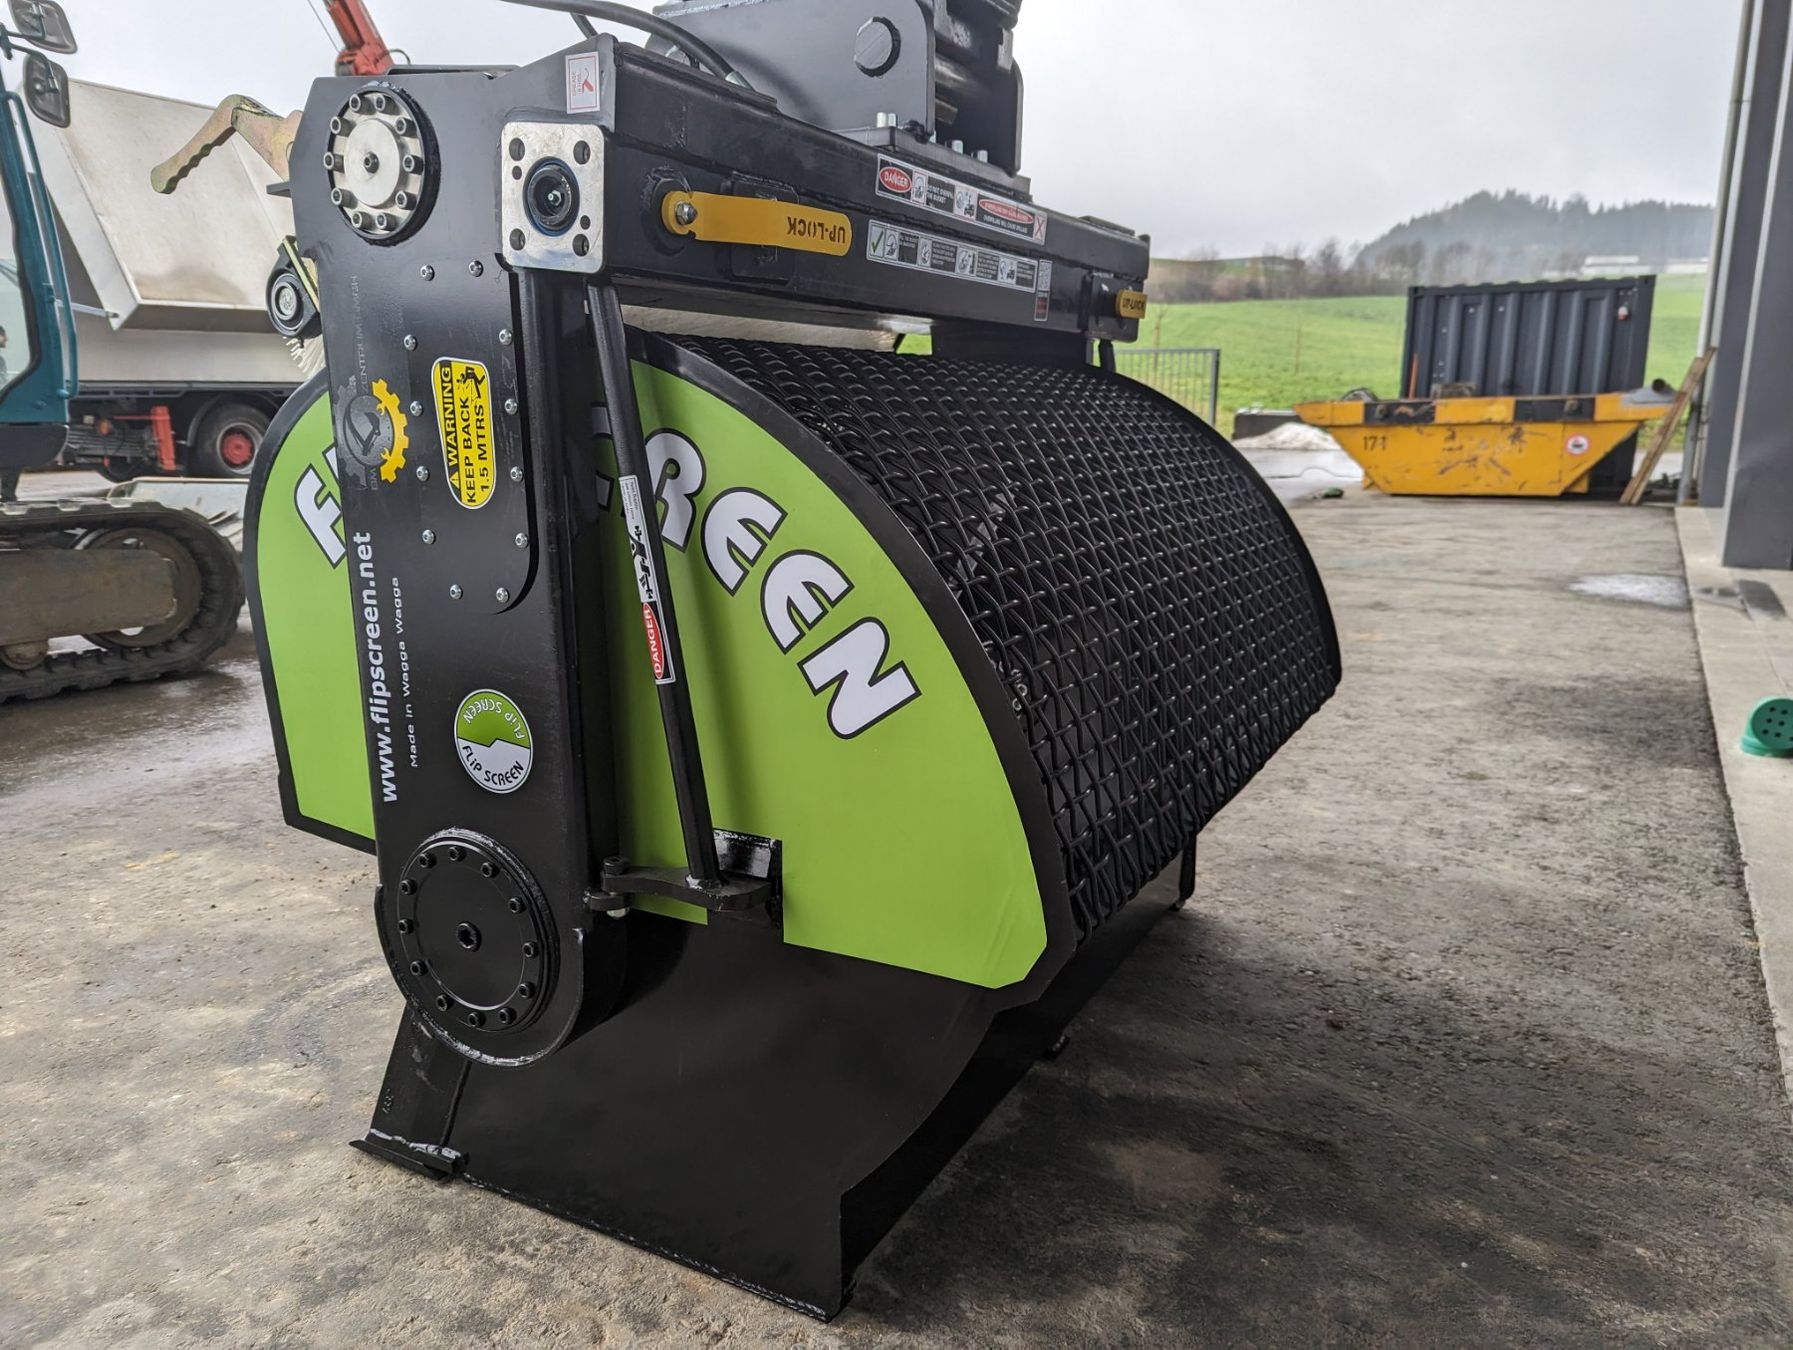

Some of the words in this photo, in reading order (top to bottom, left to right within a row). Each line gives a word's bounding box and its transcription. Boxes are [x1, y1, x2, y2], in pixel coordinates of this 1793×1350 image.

[884, 172, 908, 189] DANGER
[441, 366, 459, 466] WARNING
[459, 397, 472, 448] BACK
[474, 404, 488, 460] MTRS
[462, 455, 477, 503] KEEP
[479, 467, 489, 492] 1.5
[391, 577, 404, 634] Wagga
[644, 608, 663, 674] DANGER
[353, 532, 398, 803] www.flipscreen.net
[399, 641, 411, 697] Wagga
[463, 699, 503, 724] SCREEN
[410, 724, 418, 768] Made
[484, 760, 524, 786] SCREEN
